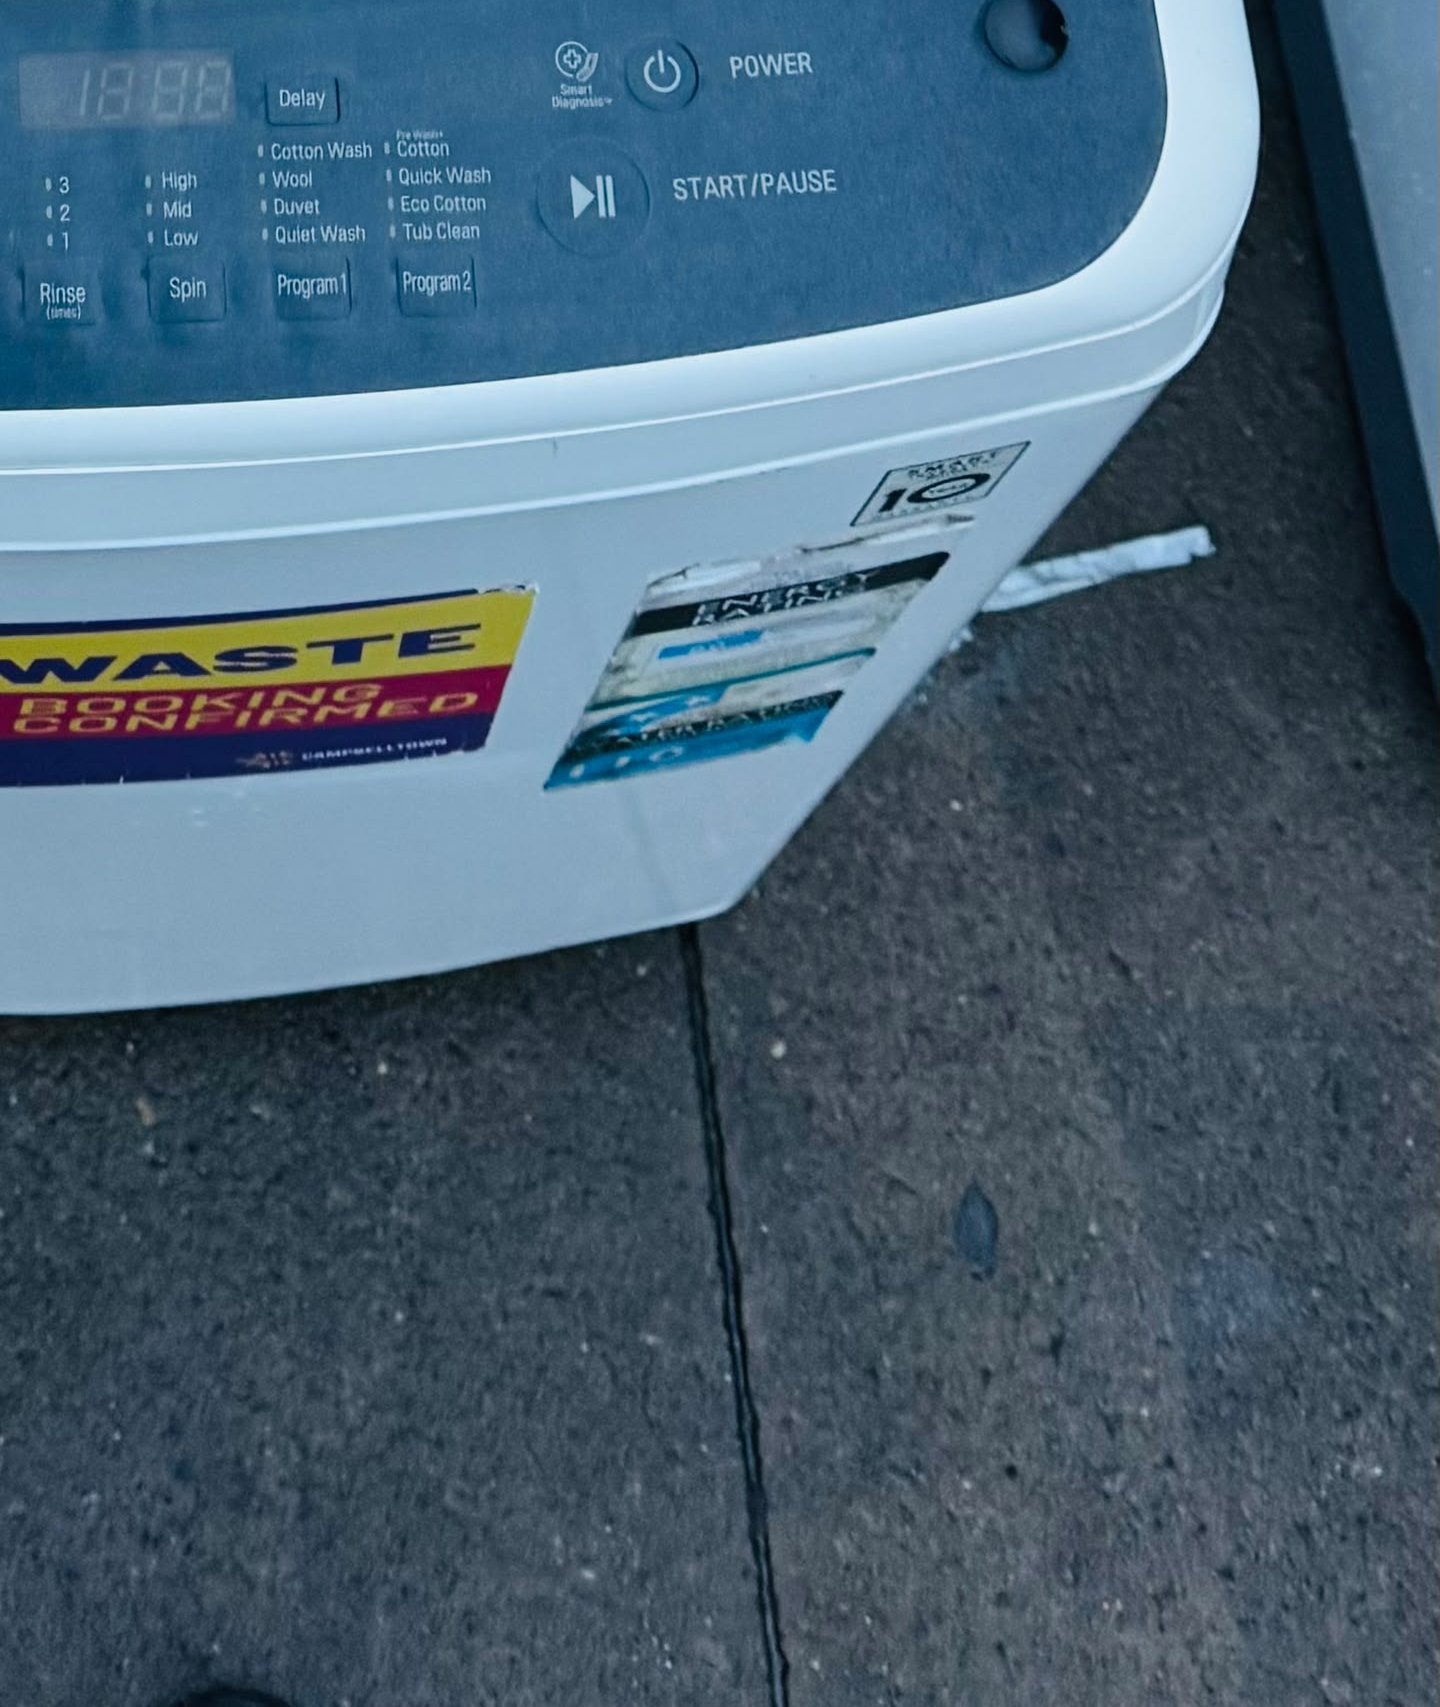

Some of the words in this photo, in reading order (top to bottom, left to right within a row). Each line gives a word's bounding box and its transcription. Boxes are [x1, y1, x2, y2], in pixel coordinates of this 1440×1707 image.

[729, 52, 813, 79] POWER
[279, 88, 325, 111] Delay
[271, 143, 323, 160] Cotton
[327, 141, 373, 158] Wash
[397, 140, 449, 157] Cotton
[59, 176, 70, 193] 3
[162, 172, 197, 191] High
[272, 171, 313, 188] Wool
[399, 168, 442, 185] Quick
[446, 167, 491, 184] Wash
[673, 169, 837, 201] START/PAUSE
[163, 201, 192, 219] Mid
[274, 198, 320, 215] Duvet
[401, 196, 429, 212] Eco
[433, 194, 486, 211] Cotton
[60, 205, 70, 221] 2
[164, 230, 199, 246] Low
[275, 226, 316, 244] Quiet
[321, 224, 366, 243] Wash
[403, 223, 432, 240] Tub
[436, 221, 480, 239] Clean
[62, 233, 69, 250] 1
[169, 277, 207, 303] Spin
[278, 273, 338, 299] Program
[403, 271, 460, 296] Program
[462, 270, 471, 290] 2
[40, 282, 86, 305] Rinse
[19, 684, 384, 716] BOOKING
[13, 691, 478, 734] CONFIRMED
